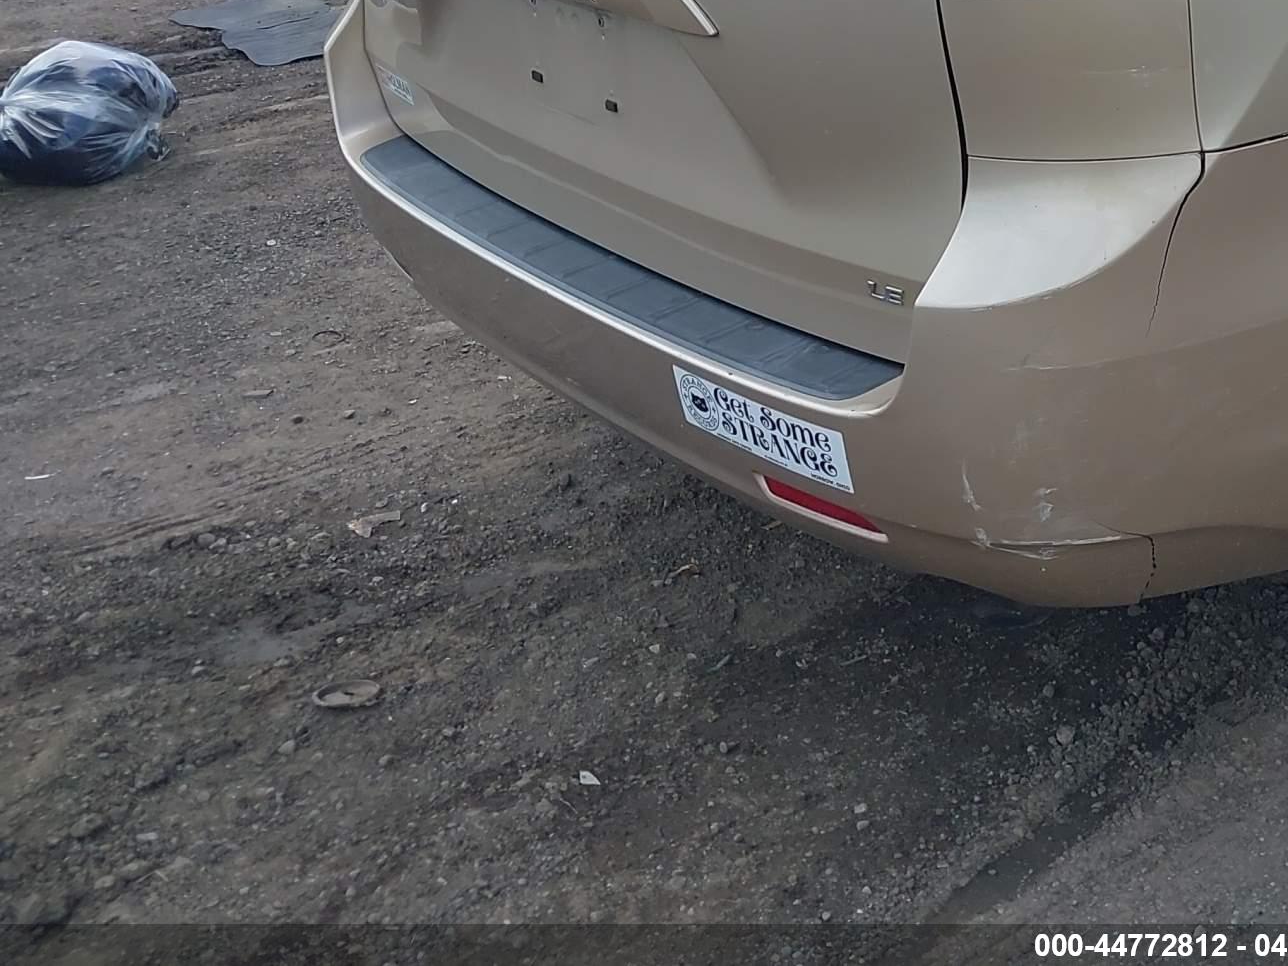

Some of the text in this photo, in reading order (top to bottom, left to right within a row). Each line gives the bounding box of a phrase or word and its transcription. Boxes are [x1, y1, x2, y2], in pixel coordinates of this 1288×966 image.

[866, 279, 904, 305] LE
[714, 387, 754, 423] Get
[760, 407, 831, 453] Some
[722, 412, 837, 477] STRANGE
